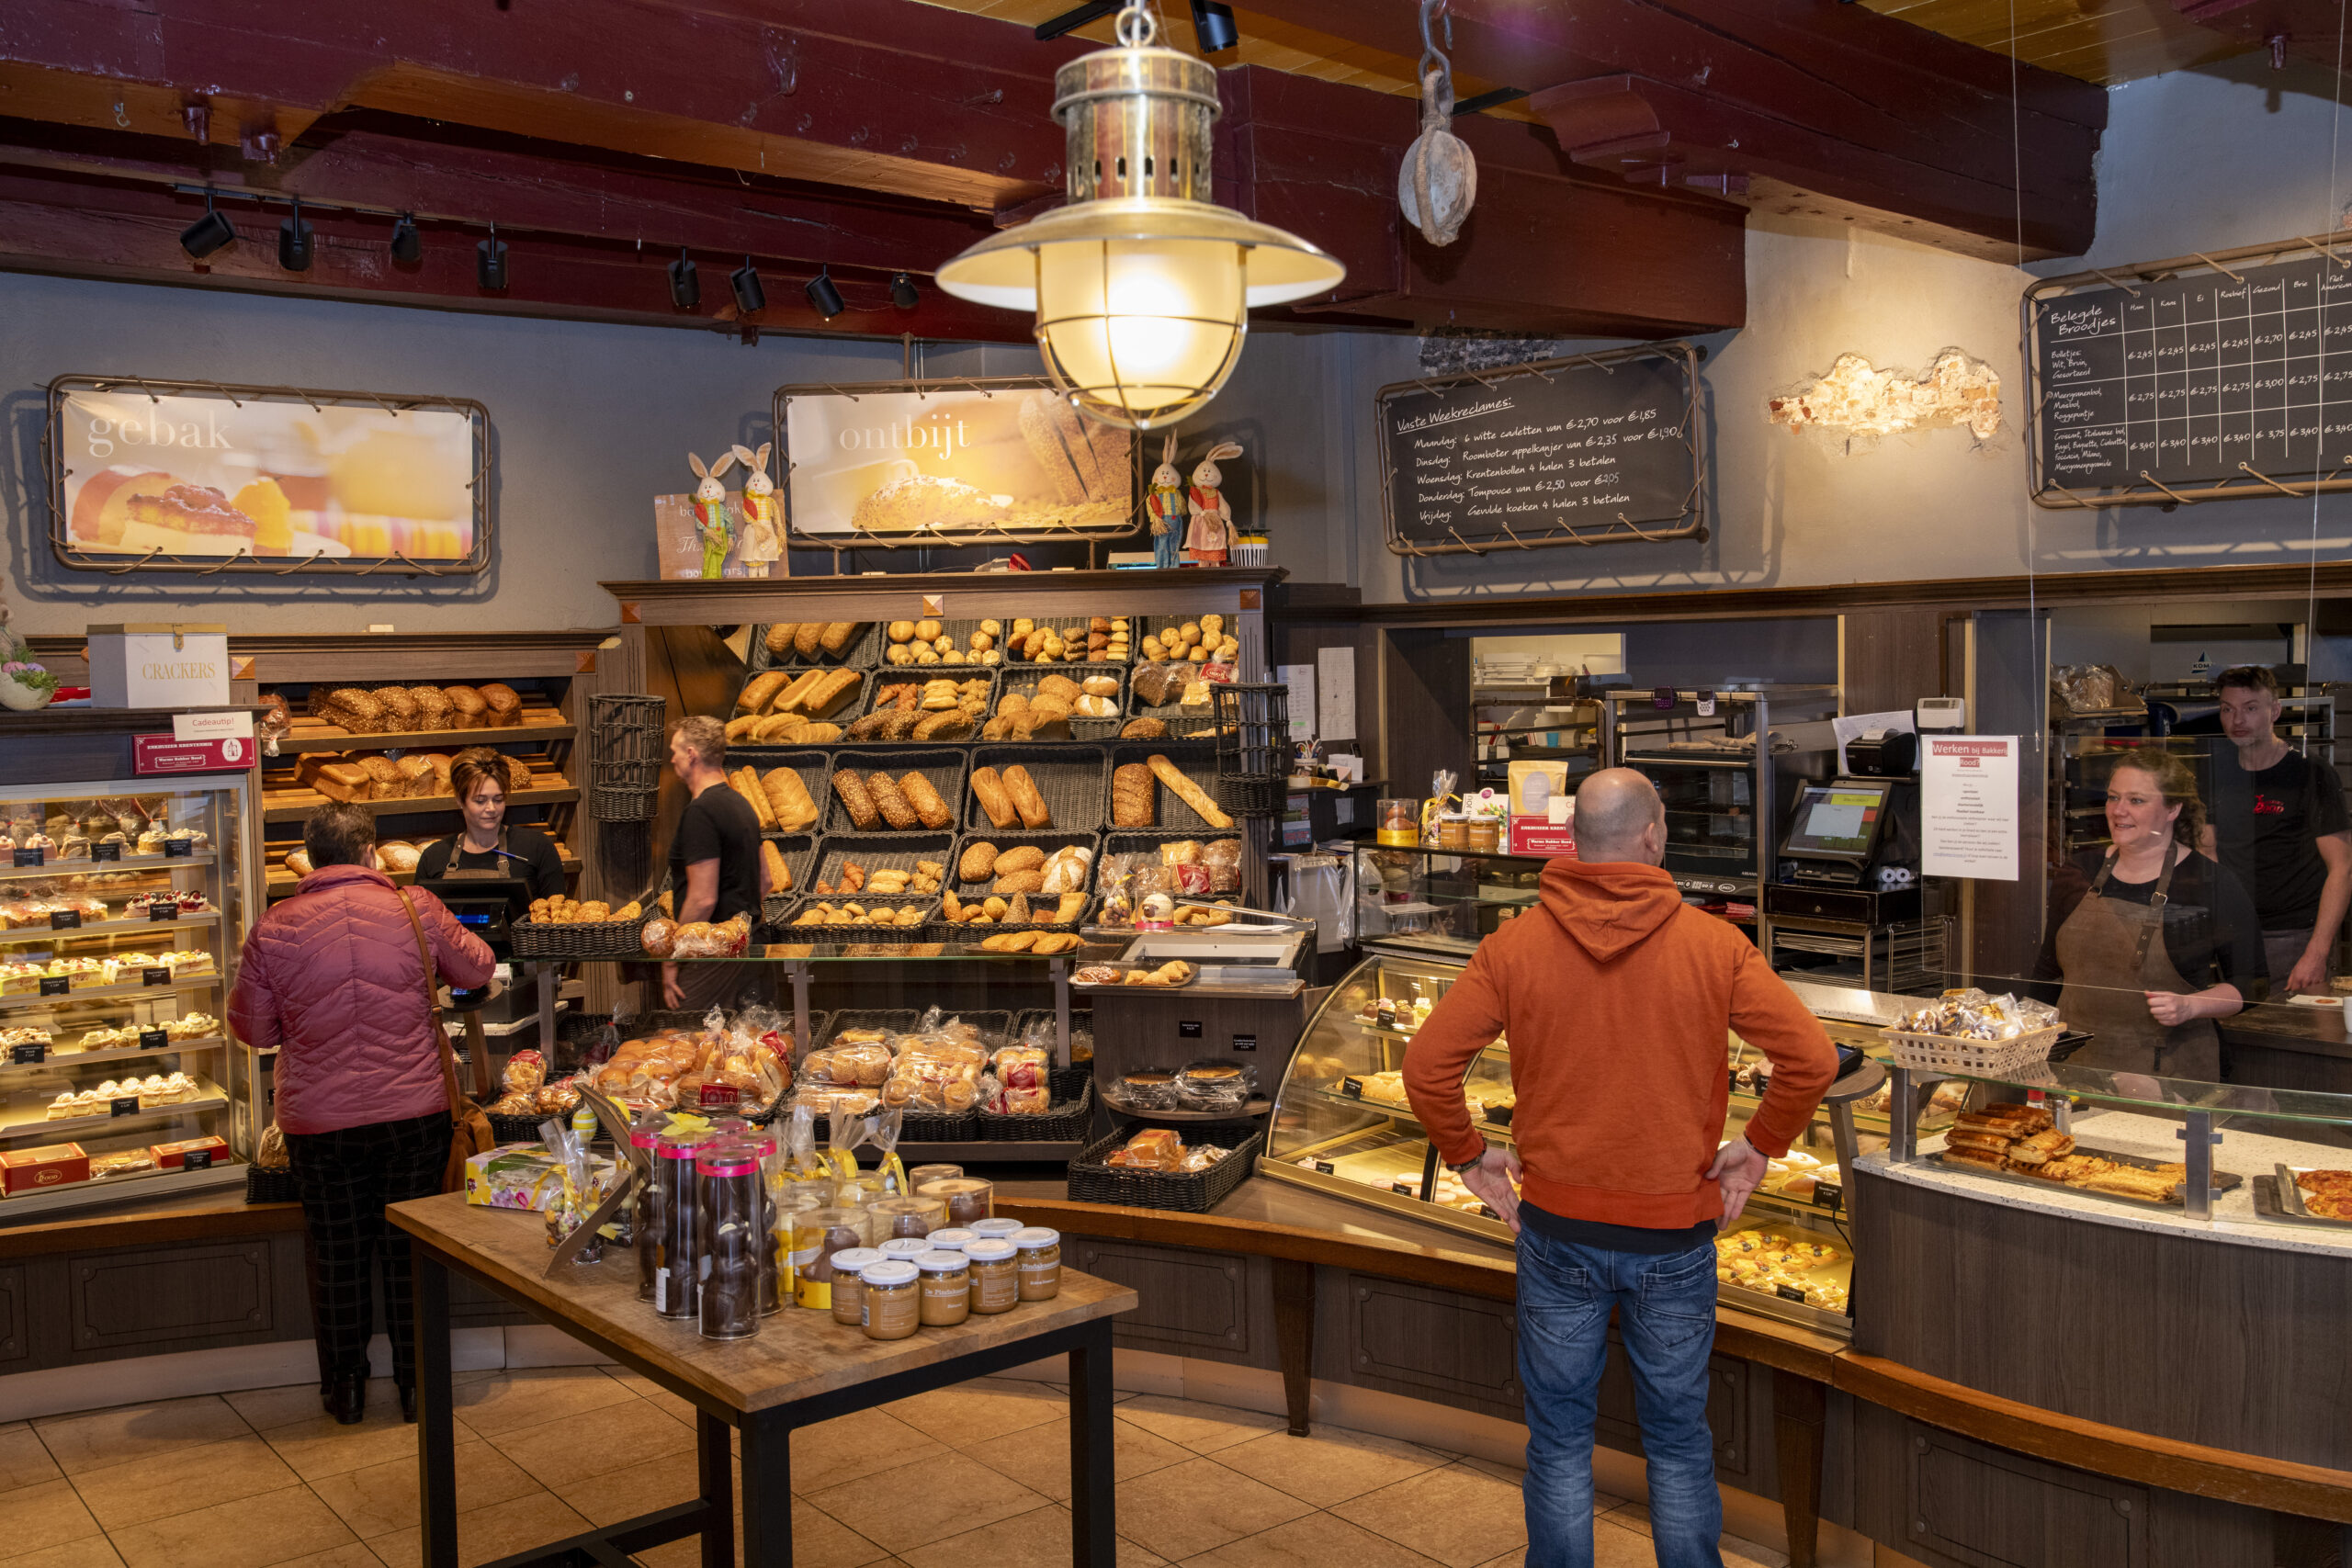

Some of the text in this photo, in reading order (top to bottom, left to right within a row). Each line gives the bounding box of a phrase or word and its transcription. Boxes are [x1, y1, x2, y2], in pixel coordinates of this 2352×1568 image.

[2196, 294, 2205, 302] Ei
[2220, 287, 2247, 299] Rosbief
[2252, 283, 2281, 294] Gezond
[2293, 280, 2309, 288] Brie
[2321, 282, 2352, 291] American
[2051, 304, 2102, 324] Belegde
[2059, 317, 2116, 335] Broodjes
[2052, 359, 2087, 370] Wit, Bruin,
[2052, 367, 2091, 379] Gesorteerd
[1396, 396, 1512, 432] Vaste Weekreclames:
[2053, 410, 2095, 423] Roggepuntje
[87, 407, 234, 457] gebak
[839, 412, 971, 460] ontbijt
[1414, 436, 1457, 449] Maandag:
[1464, 434, 1471, 443] 6
[1474, 431, 1497, 442] witte
[1500, 425, 1543, 439] cadetten
[1545, 423, 1562, 433] van
[1602, 415, 1625, 425] voor
[1416, 455, 1451, 468] Dinsdag:
[1463, 446, 1510, 461] Roomboter
[1511, 442, 1564, 460] appelkanjer
[1566, 440, 1582, 450] van
[1623, 433, 1645, 443] voor
[1417, 455, 1616, 486] Woensdag: Krentenbollen 4 halen 3 betalen
[1419, 491, 1465, 504] Donderdag:
[1467, 485, 1512, 501] Tompouce
[1516, 486, 1532, 494] van
[1569, 479, 1591, 489] voor
[1419, 492, 1631, 525] Vrijdag: Gevulde koeken 4 halen 3 betalen
[141, 661, 216, 680] CRACKERS
[192, 717, 235, 727] Cadeautip!
[1932, 743, 2007, 756] Werken bij Bakkerij
